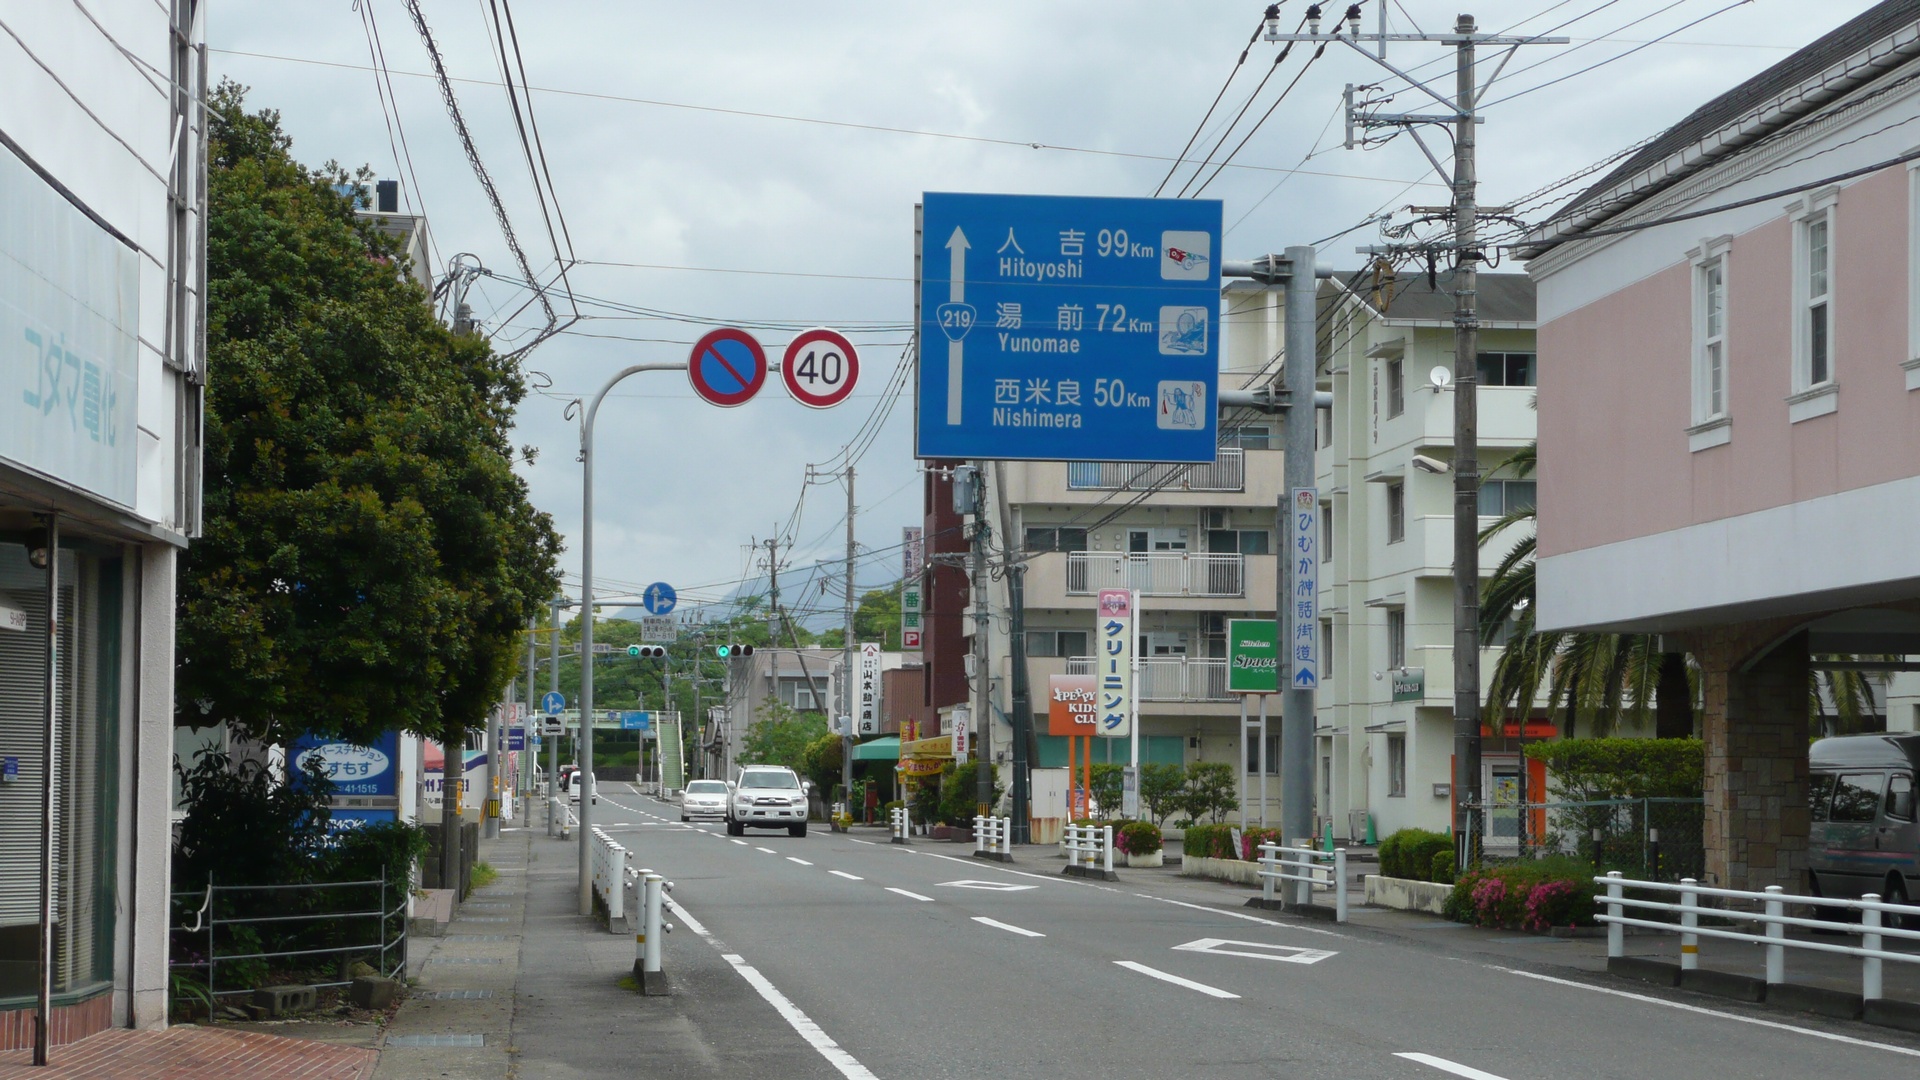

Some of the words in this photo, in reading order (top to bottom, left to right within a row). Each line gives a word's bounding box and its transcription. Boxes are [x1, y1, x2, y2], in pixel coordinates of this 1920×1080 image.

[997, 227, 1085, 257] 人吉
[999, 257, 1083, 281] Hitoyoshi
[943, 309, 970, 328] 219
[995, 301, 1084, 332] 湯前
[998, 332, 1081, 354] Yunomae
[796, 350, 841, 385] 40
[23, 326, 116, 448] コダマ電化
[994, 377, 1083, 407] 西米良
[993, 407, 1082, 429] Nishimera
[1296, 512, 1315, 663] ひむか神話街道
[9, 611, 26, 627] SHARP
[1239, 639, 1270, 648] Kitchen
[1233, 654, 1277, 669] Space
[1103, 619, 1125, 730] クリーニング
[1062, 687, 1096, 703] PEPPY
[1074, 714, 1097, 724] CLU
